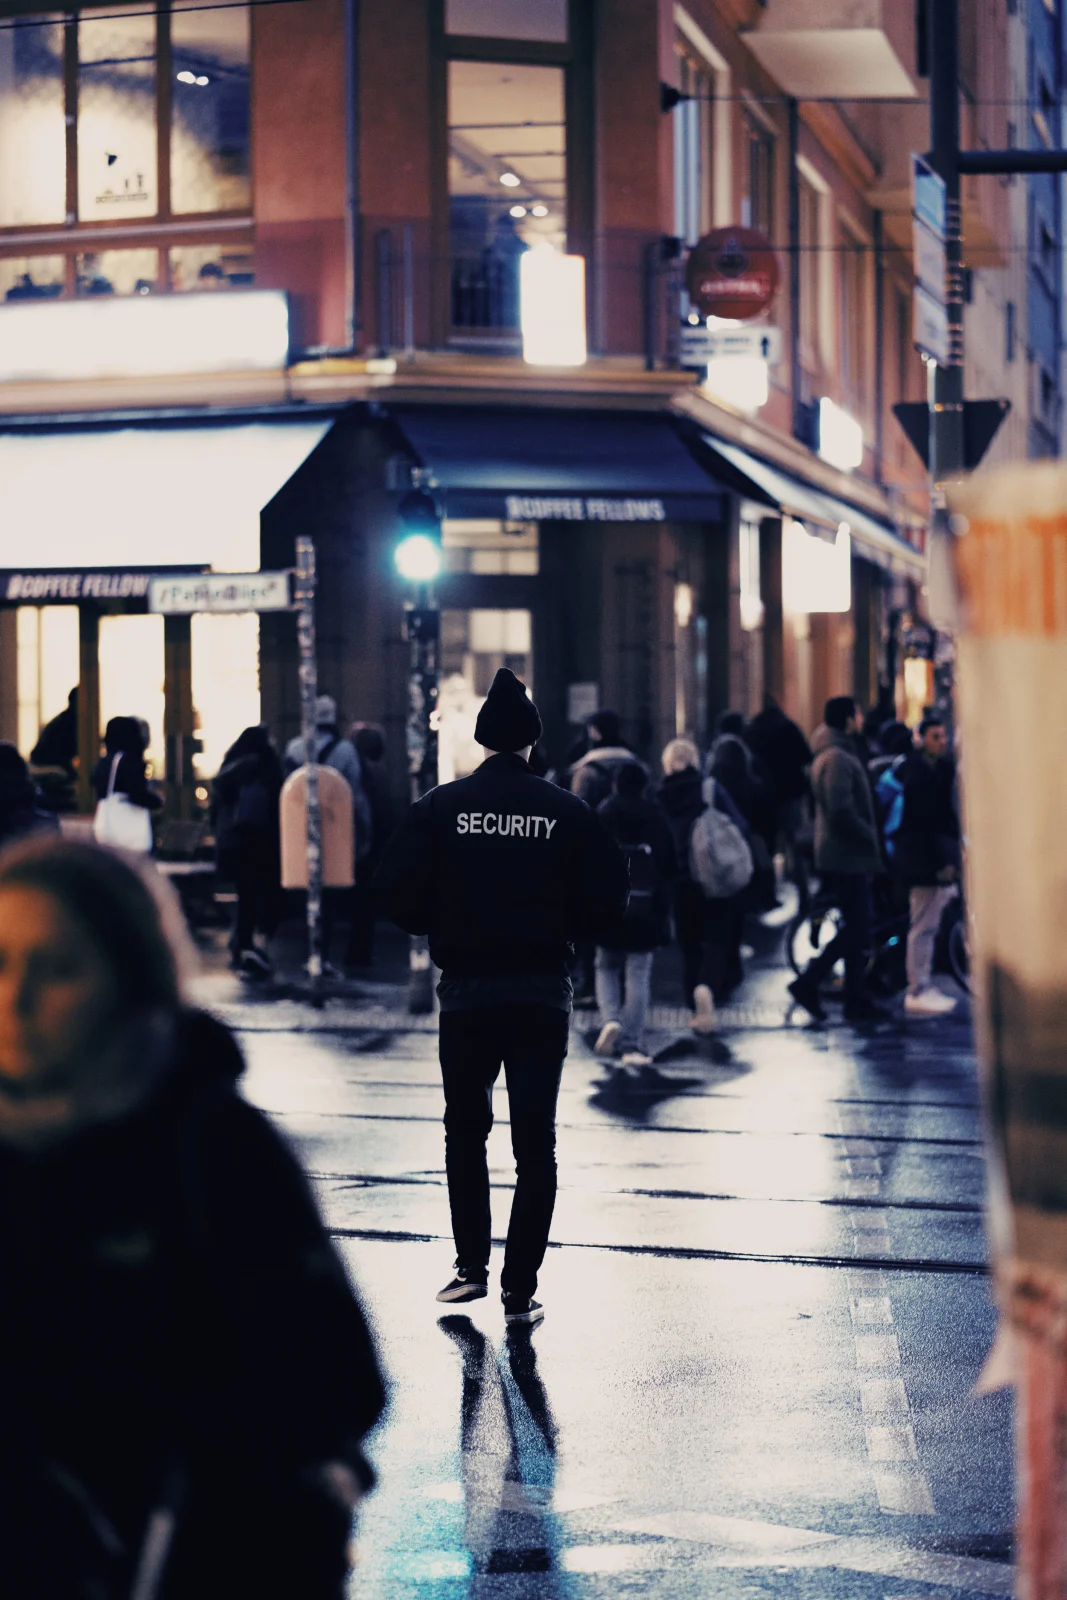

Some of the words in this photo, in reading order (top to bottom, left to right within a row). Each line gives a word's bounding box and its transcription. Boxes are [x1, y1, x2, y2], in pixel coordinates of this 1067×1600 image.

[521, 497, 584, 520] COFFEE
[586, 498, 665, 521] FELLOWS
[20, 574, 82, 599] COFFEE
[83, 573, 150, 598] FELLOW
[456, 812, 557, 839] SECURITY
